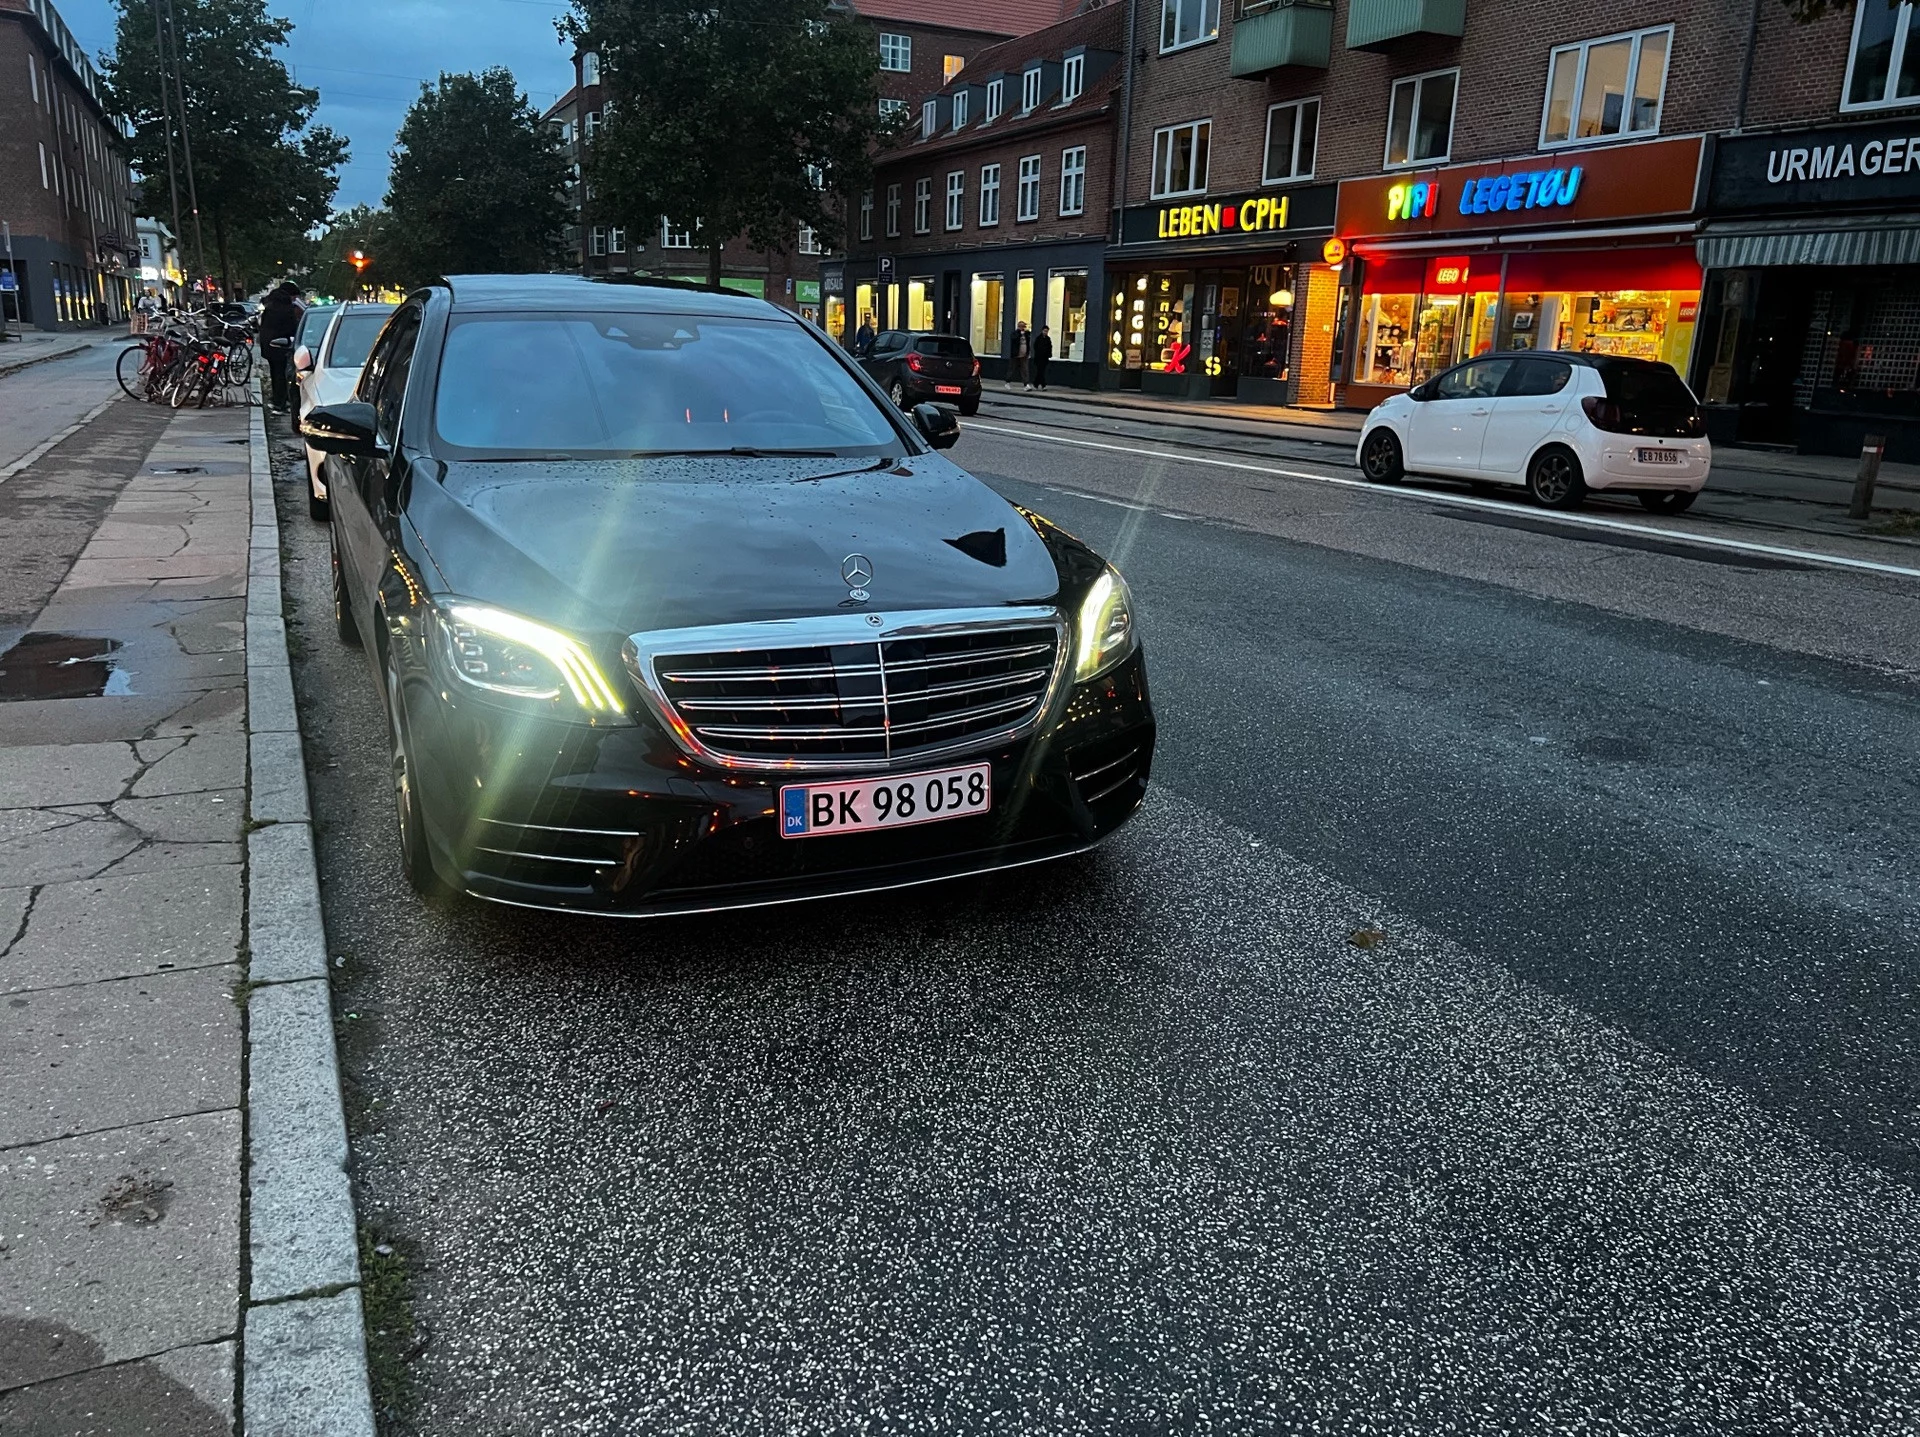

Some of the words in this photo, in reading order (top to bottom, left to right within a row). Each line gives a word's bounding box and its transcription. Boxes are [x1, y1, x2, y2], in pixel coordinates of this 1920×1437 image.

[1766, 137, 1920, 183] URMAGER
[1387, 181, 1439, 221] PIPI
[1458, 167, 1584, 216] LEGETØJ
[1158, 204, 1221, 239] LEBEN
[1239, 196, 1289, 232] CPH
[881, 258, 891, 272] P
[1436, 268, 1460, 284] LEGO
[1680, 308, 1696, 316] LEGO
[1654, 451, 1663, 462] 78
[812, 790, 862, 828] BK
[872, 782, 916, 822] 98
[925, 771, 985, 813] 058
[787, 816, 803, 827] DK
